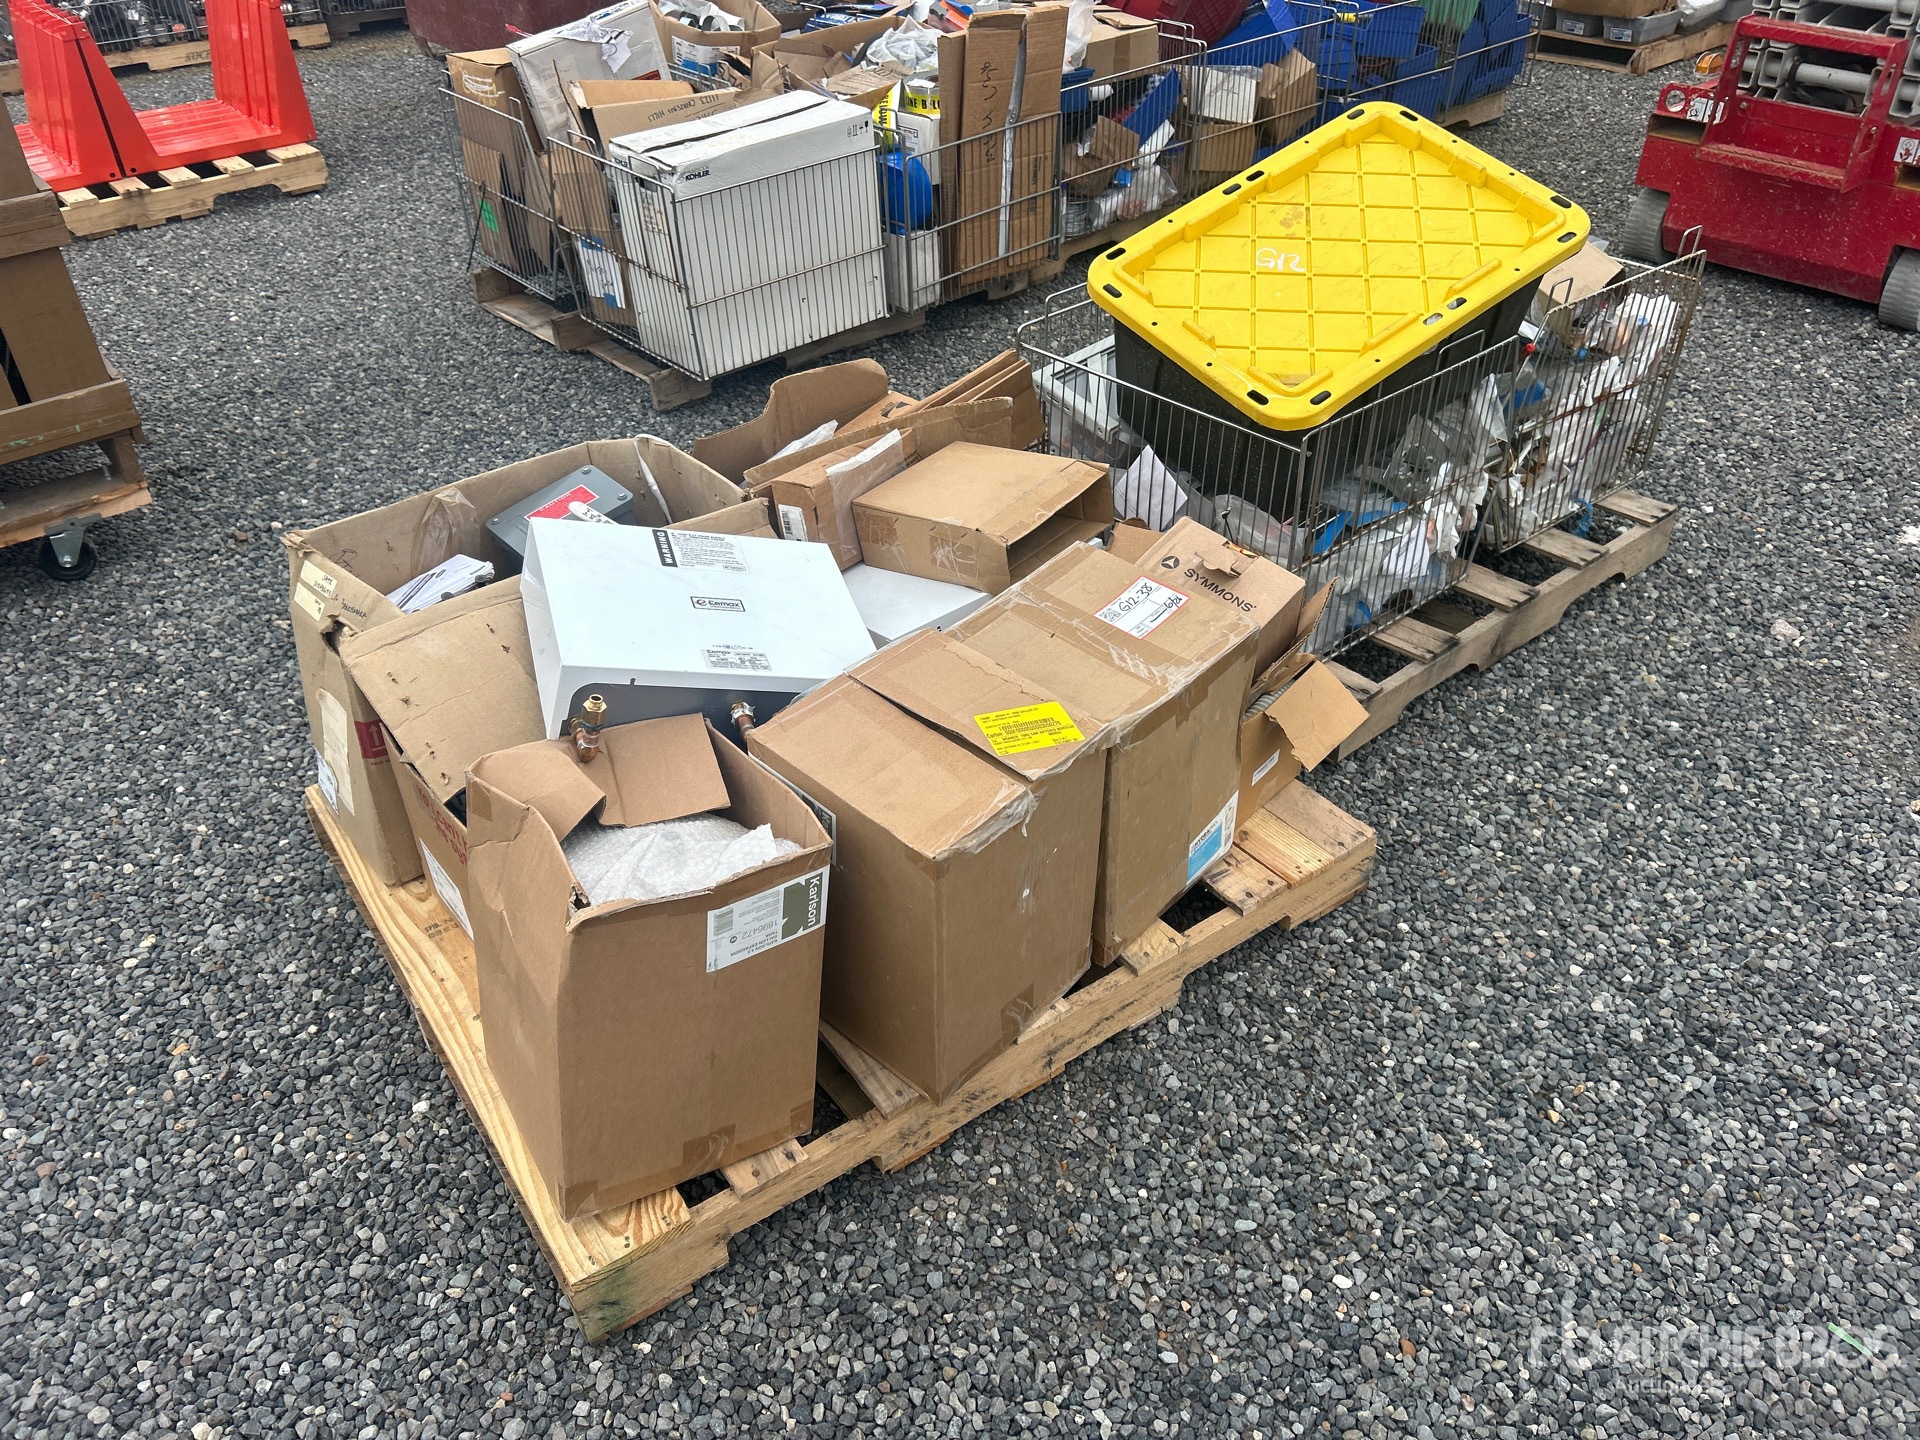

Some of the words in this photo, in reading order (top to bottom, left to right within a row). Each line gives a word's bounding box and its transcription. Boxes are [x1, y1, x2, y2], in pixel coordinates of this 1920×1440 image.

[647, 110, 666, 122] HILLS
[685, 168, 711, 181] KOHLER
[1256, 248, 1305, 272] G12
[539, 492, 572, 512] CAUTION
[656, 531, 674, 564] WARNING
[1119, 582, 1152, 612] G12-38
[1184, 568, 1254, 612] SYMMONS
[808, 877, 821, 926] Karlson
[741, 918, 777, 940] 1896472
[765, 929, 777, 938] TANK
[730, 942, 757, 956] EXPANSION
